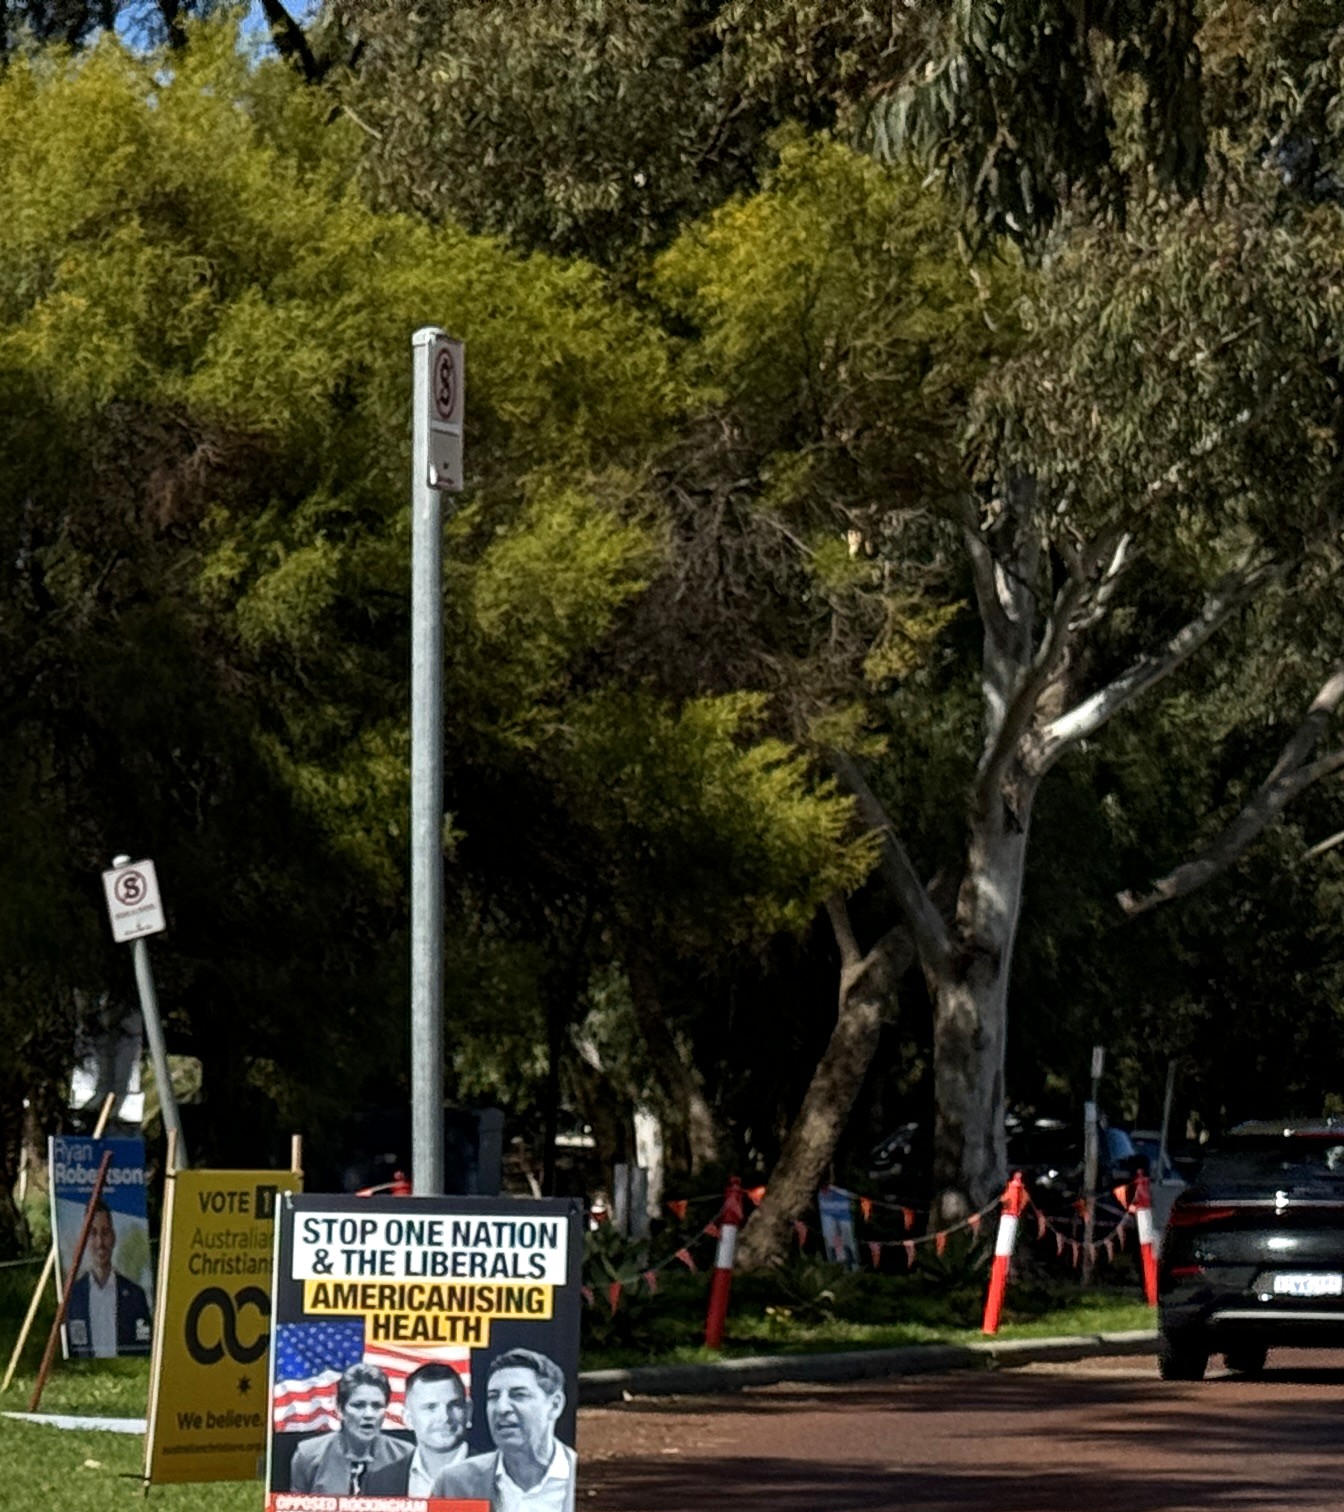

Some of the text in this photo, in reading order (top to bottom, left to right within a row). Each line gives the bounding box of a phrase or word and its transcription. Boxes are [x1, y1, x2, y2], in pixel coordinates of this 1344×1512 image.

[54, 1139, 92, 1165] Ryan
[55, 1163, 144, 1186] Robetson
[198, 1191, 250, 1213] VOTE
[303, 1218, 558, 1249] STOP ONE NATION
[188, 1252, 274, 1275] Christian
[312, 1248, 547, 1280] & THE LIBERALS
[311, 1283, 545, 1314] AMERICANISING
[372, 1314, 482, 1342] HEALTH
[177, 1411, 203, 1430] We
[276, 1496, 336, 1511] OPPOSED
